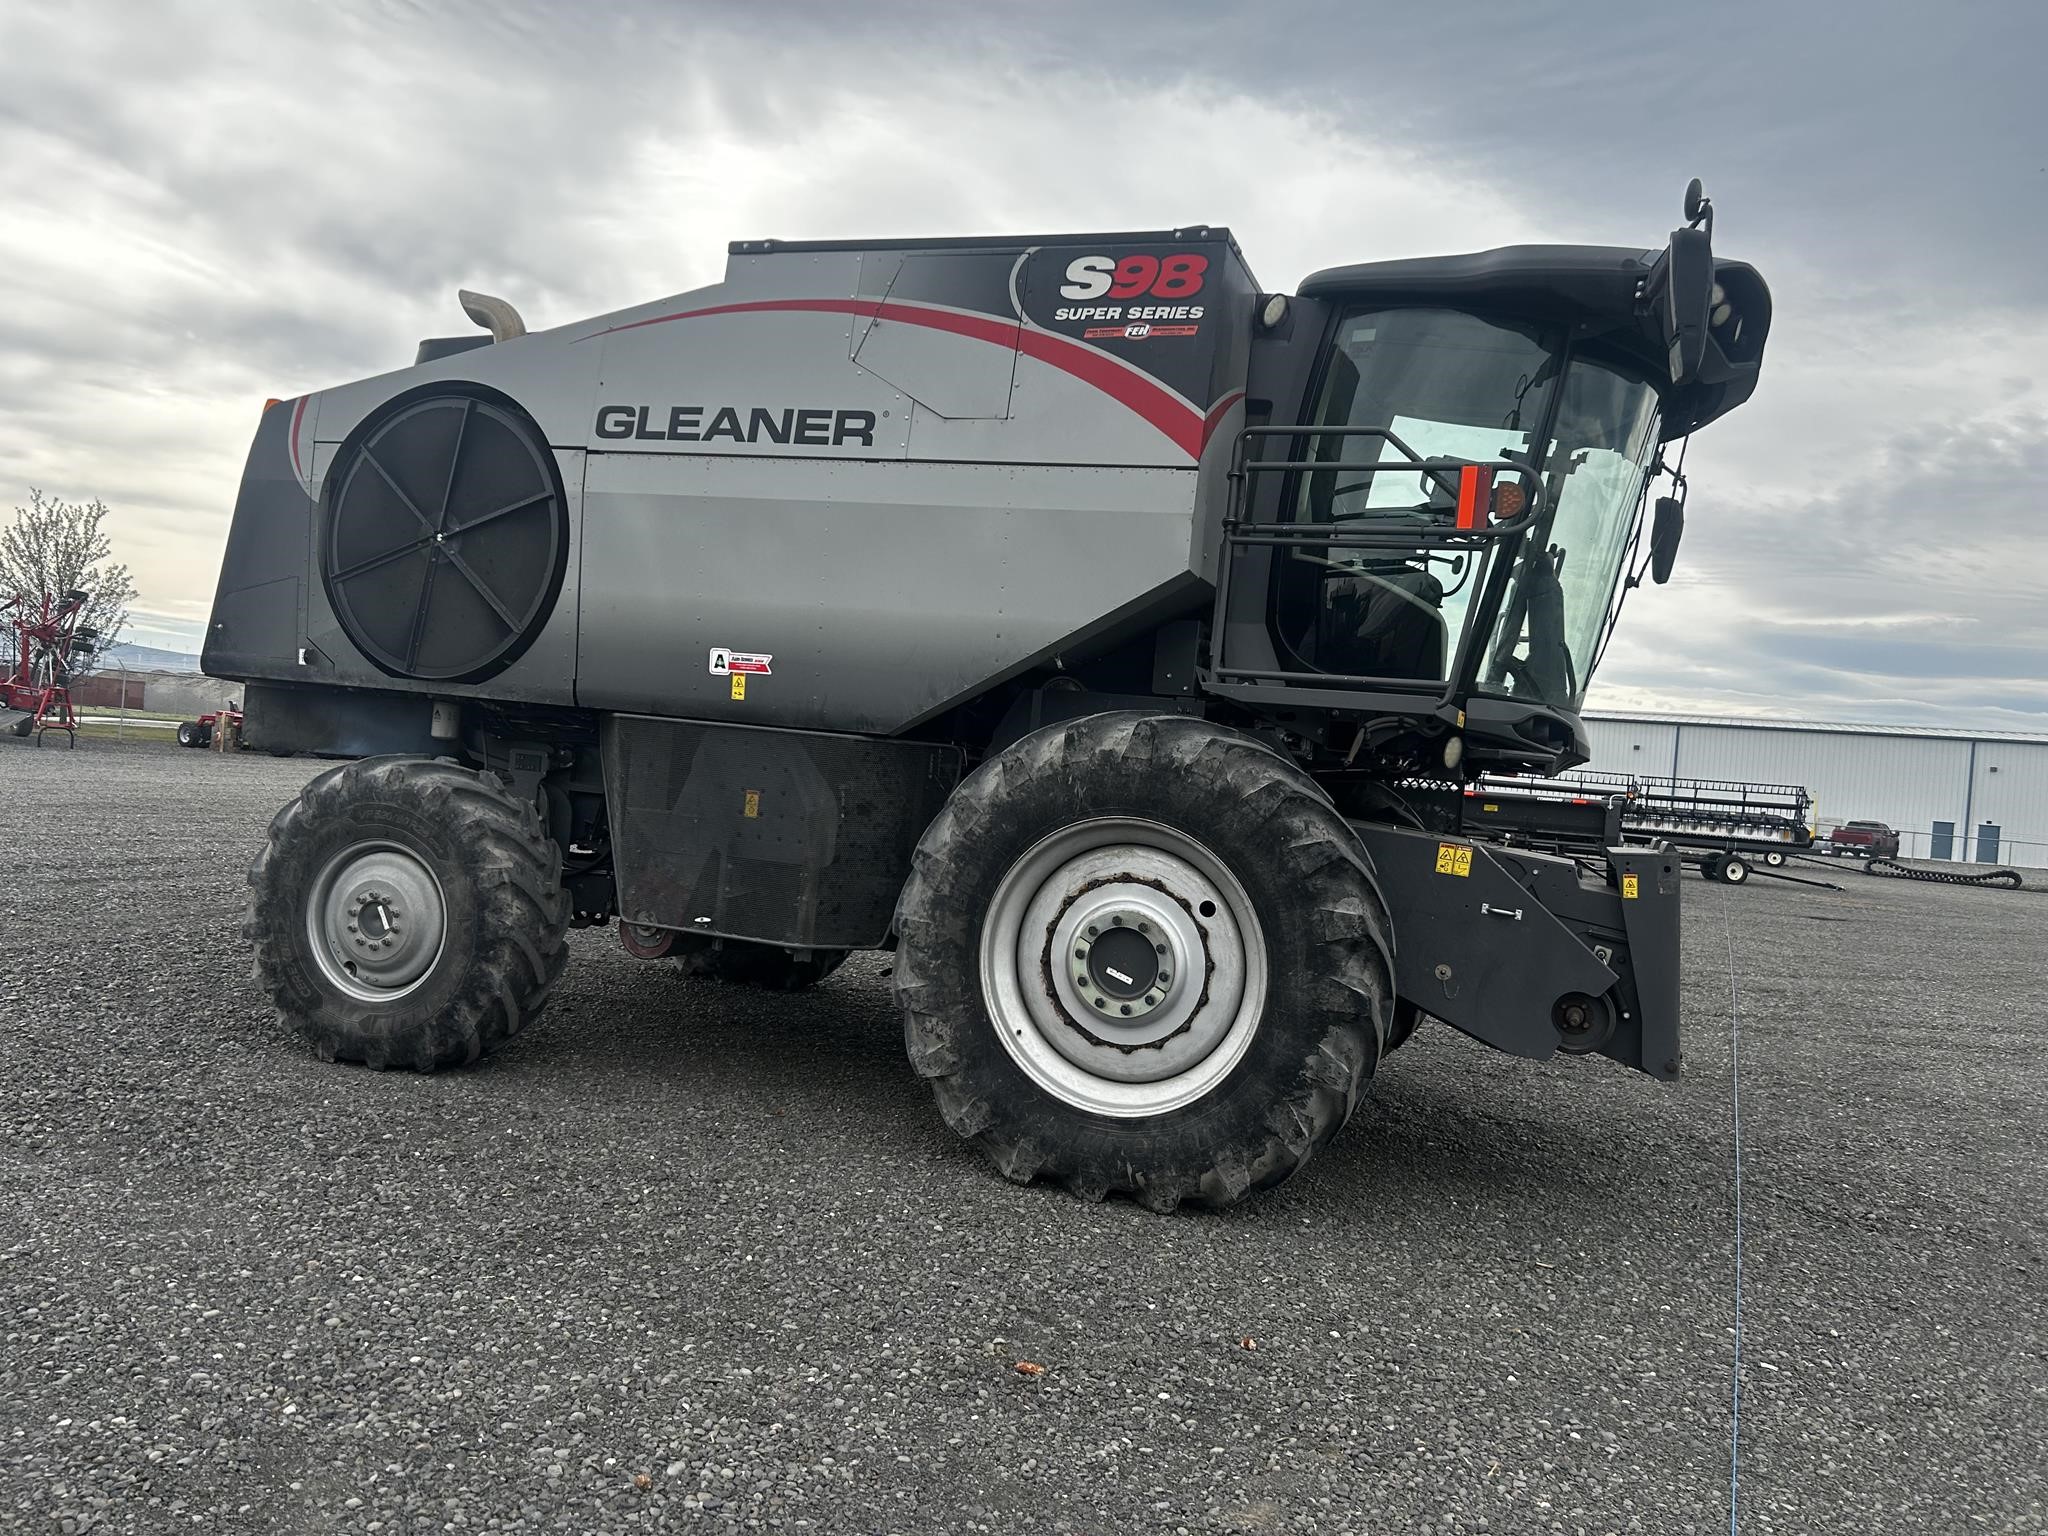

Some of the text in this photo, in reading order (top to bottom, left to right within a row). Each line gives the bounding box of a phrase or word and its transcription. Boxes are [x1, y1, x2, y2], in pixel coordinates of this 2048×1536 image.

[1060, 254, 1208, 300] S98
[1055, 306, 1204, 321] SUPER SERIES
[1124, 324, 1149, 337] FEH
[595, 405, 876, 446] GLEANER
